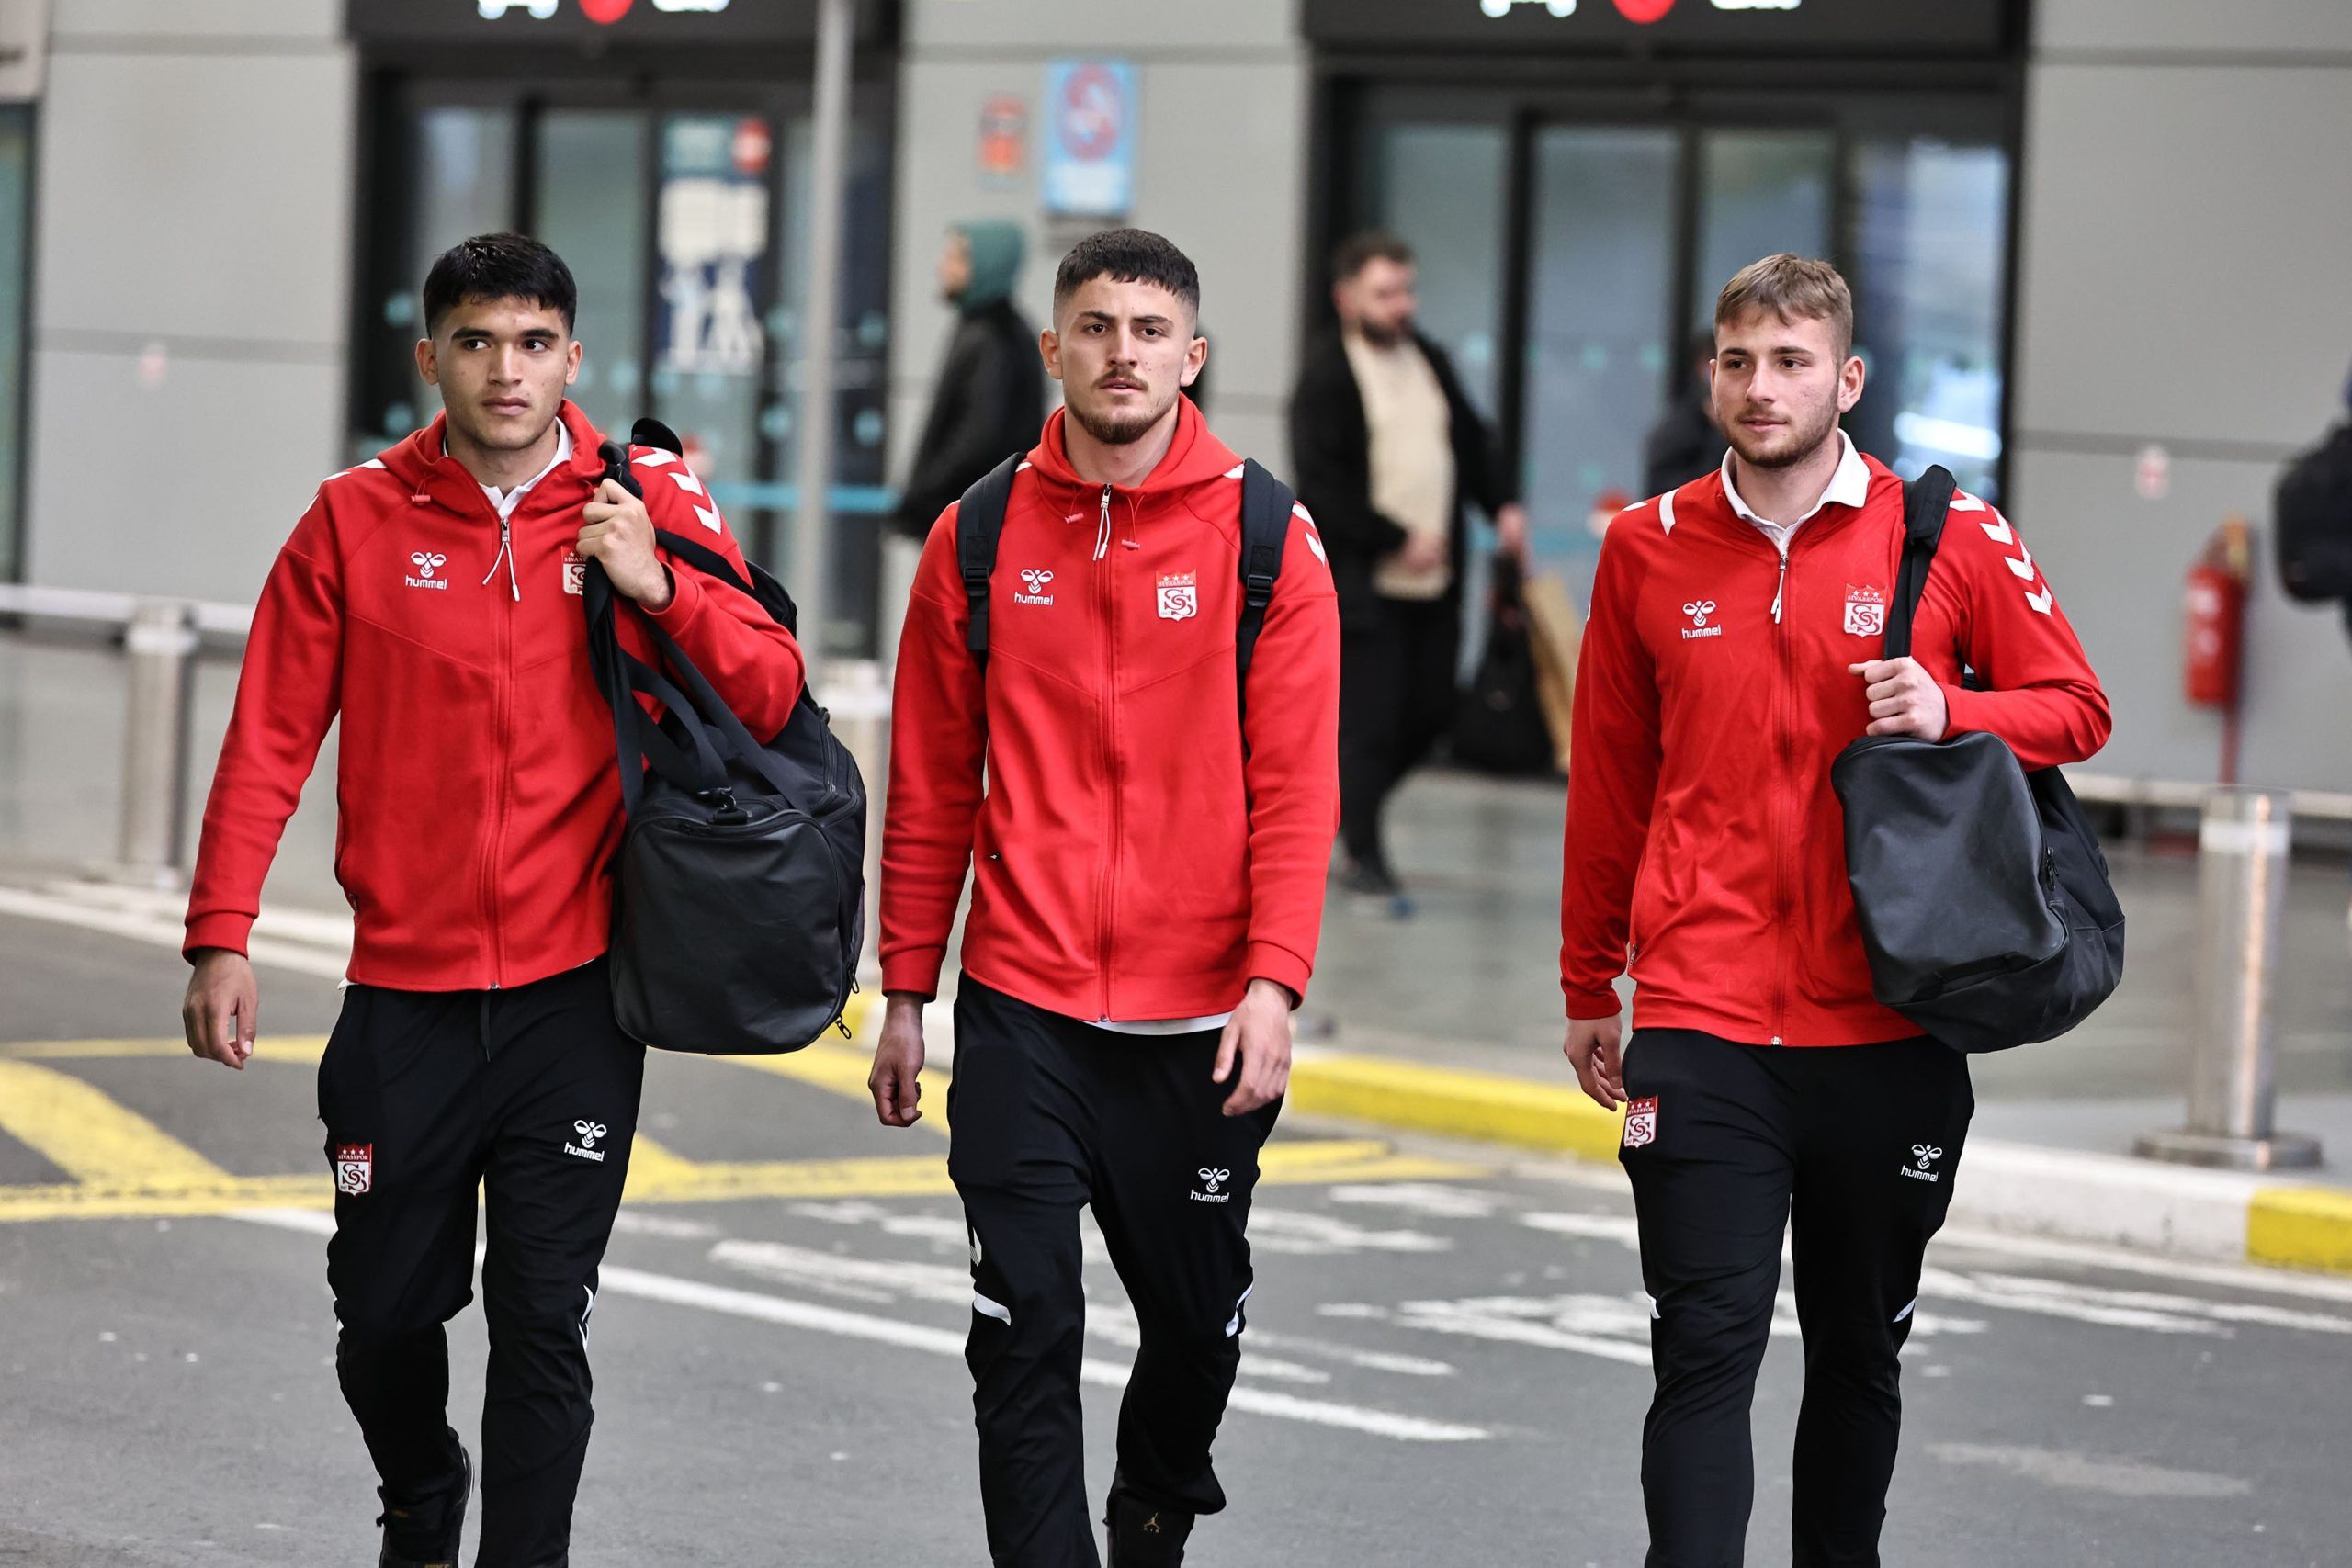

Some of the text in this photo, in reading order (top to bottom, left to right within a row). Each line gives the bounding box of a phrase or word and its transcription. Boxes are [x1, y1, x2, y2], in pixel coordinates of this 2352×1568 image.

[405, 574, 447, 590] hummel
[1014, 591, 1054, 606] hummel
[1681, 624, 1722, 640] hummel
[563, 1141, 605, 1162] hummel
[1900, 1164, 1939, 1182] hummel
[1190, 1189, 1230, 1203] hummel
